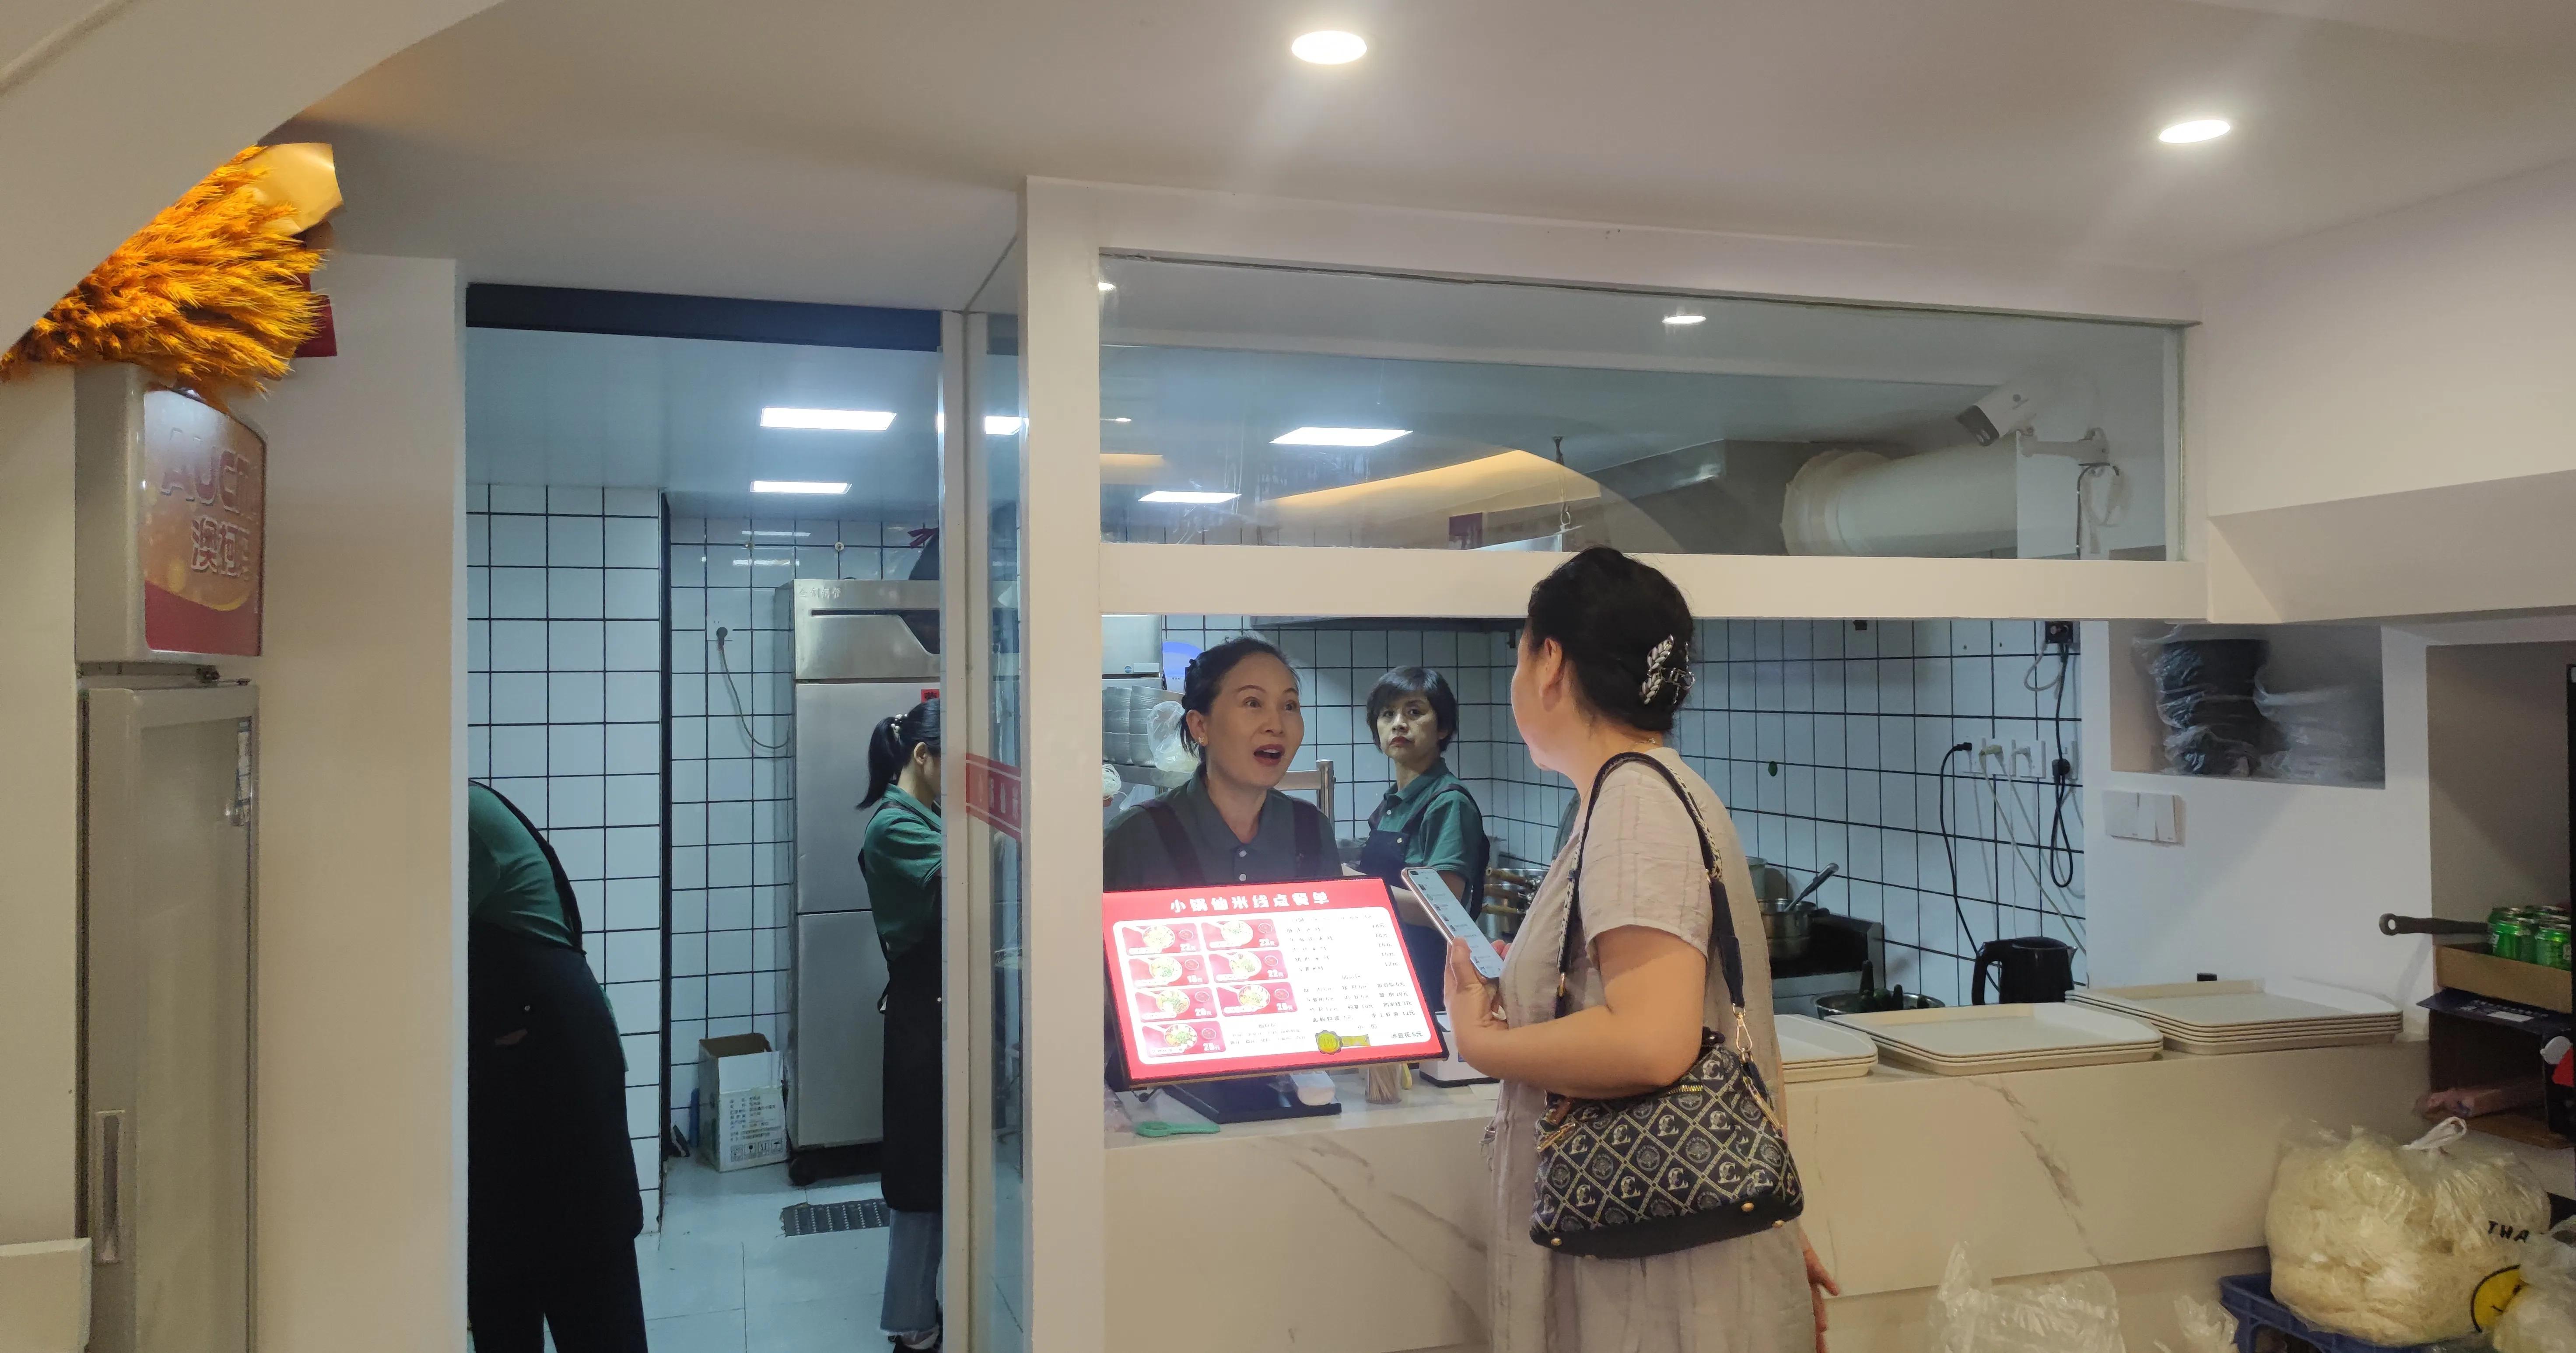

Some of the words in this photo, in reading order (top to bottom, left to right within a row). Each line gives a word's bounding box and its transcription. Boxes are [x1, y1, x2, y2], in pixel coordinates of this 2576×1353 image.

[160, 428, 251, 519] AUC
[191, 515, 250, 578] 澳柯
[2487, 1220, 2530, 1243] THA
